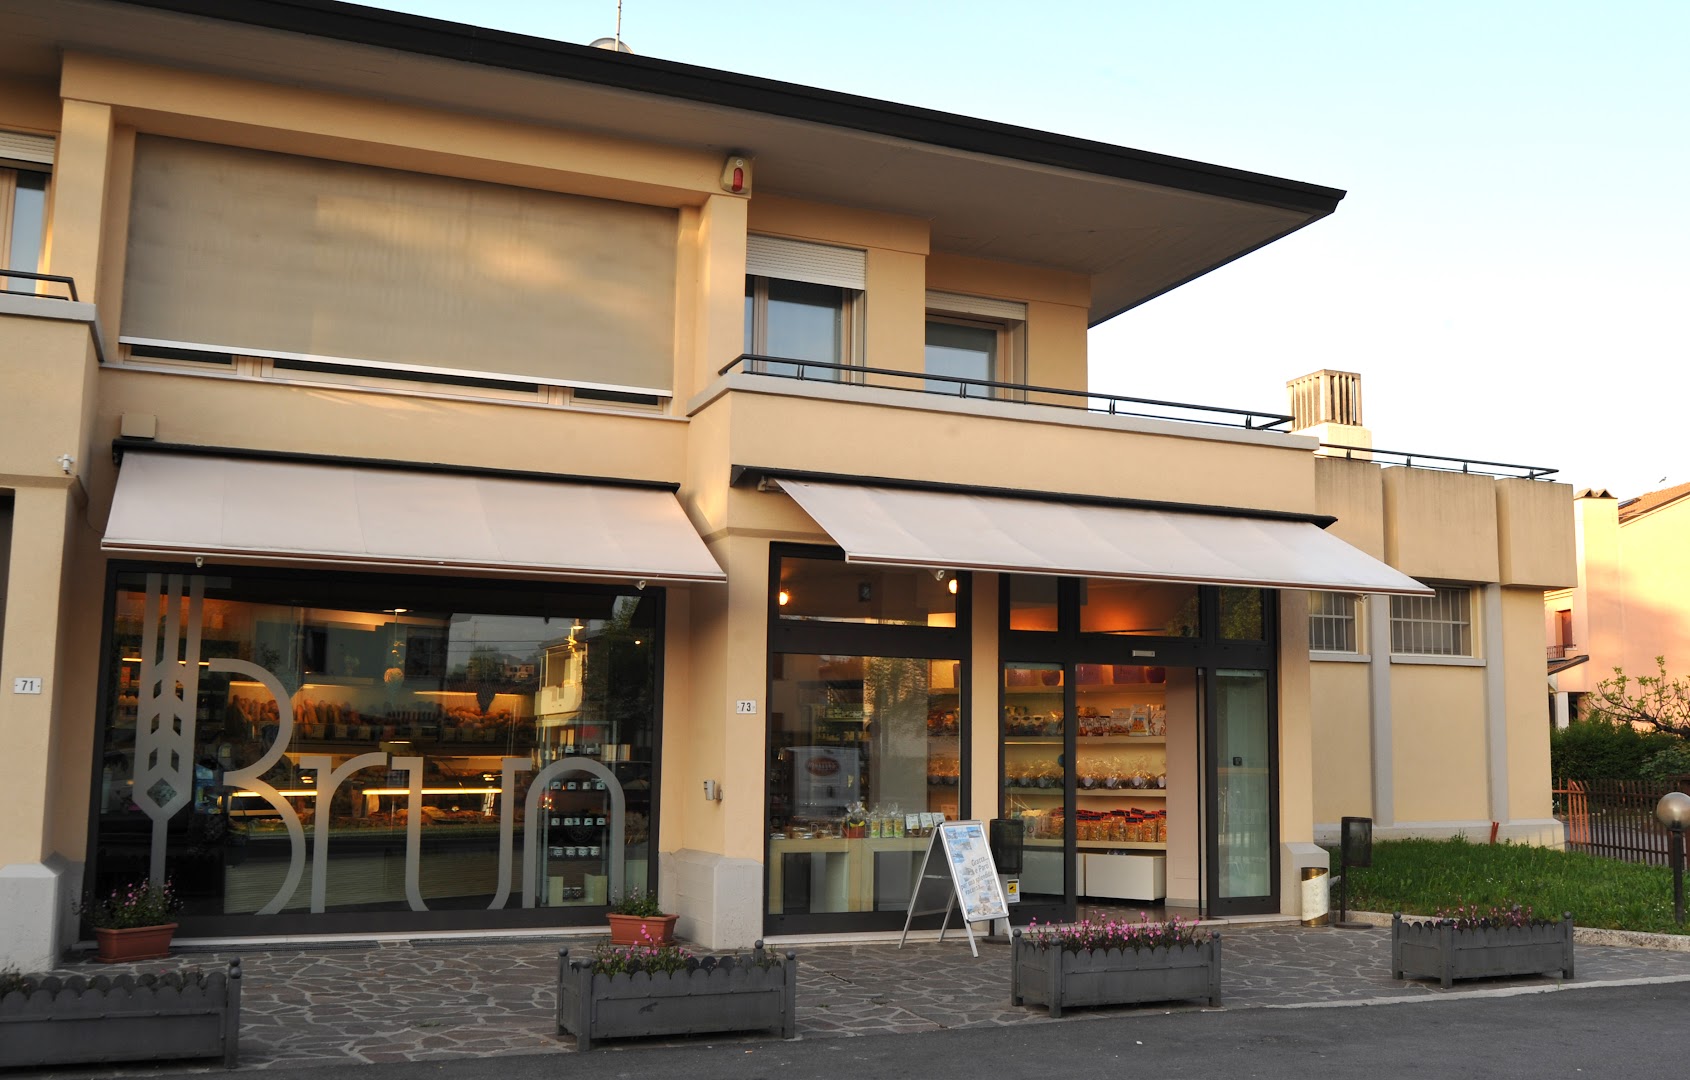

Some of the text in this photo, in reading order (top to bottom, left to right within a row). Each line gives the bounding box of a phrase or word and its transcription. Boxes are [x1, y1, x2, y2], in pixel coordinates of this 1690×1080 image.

[21, 680, 33, 691] 71
[741, 702, 751, 712] 73
[207, 657, 625, 915] Brun
